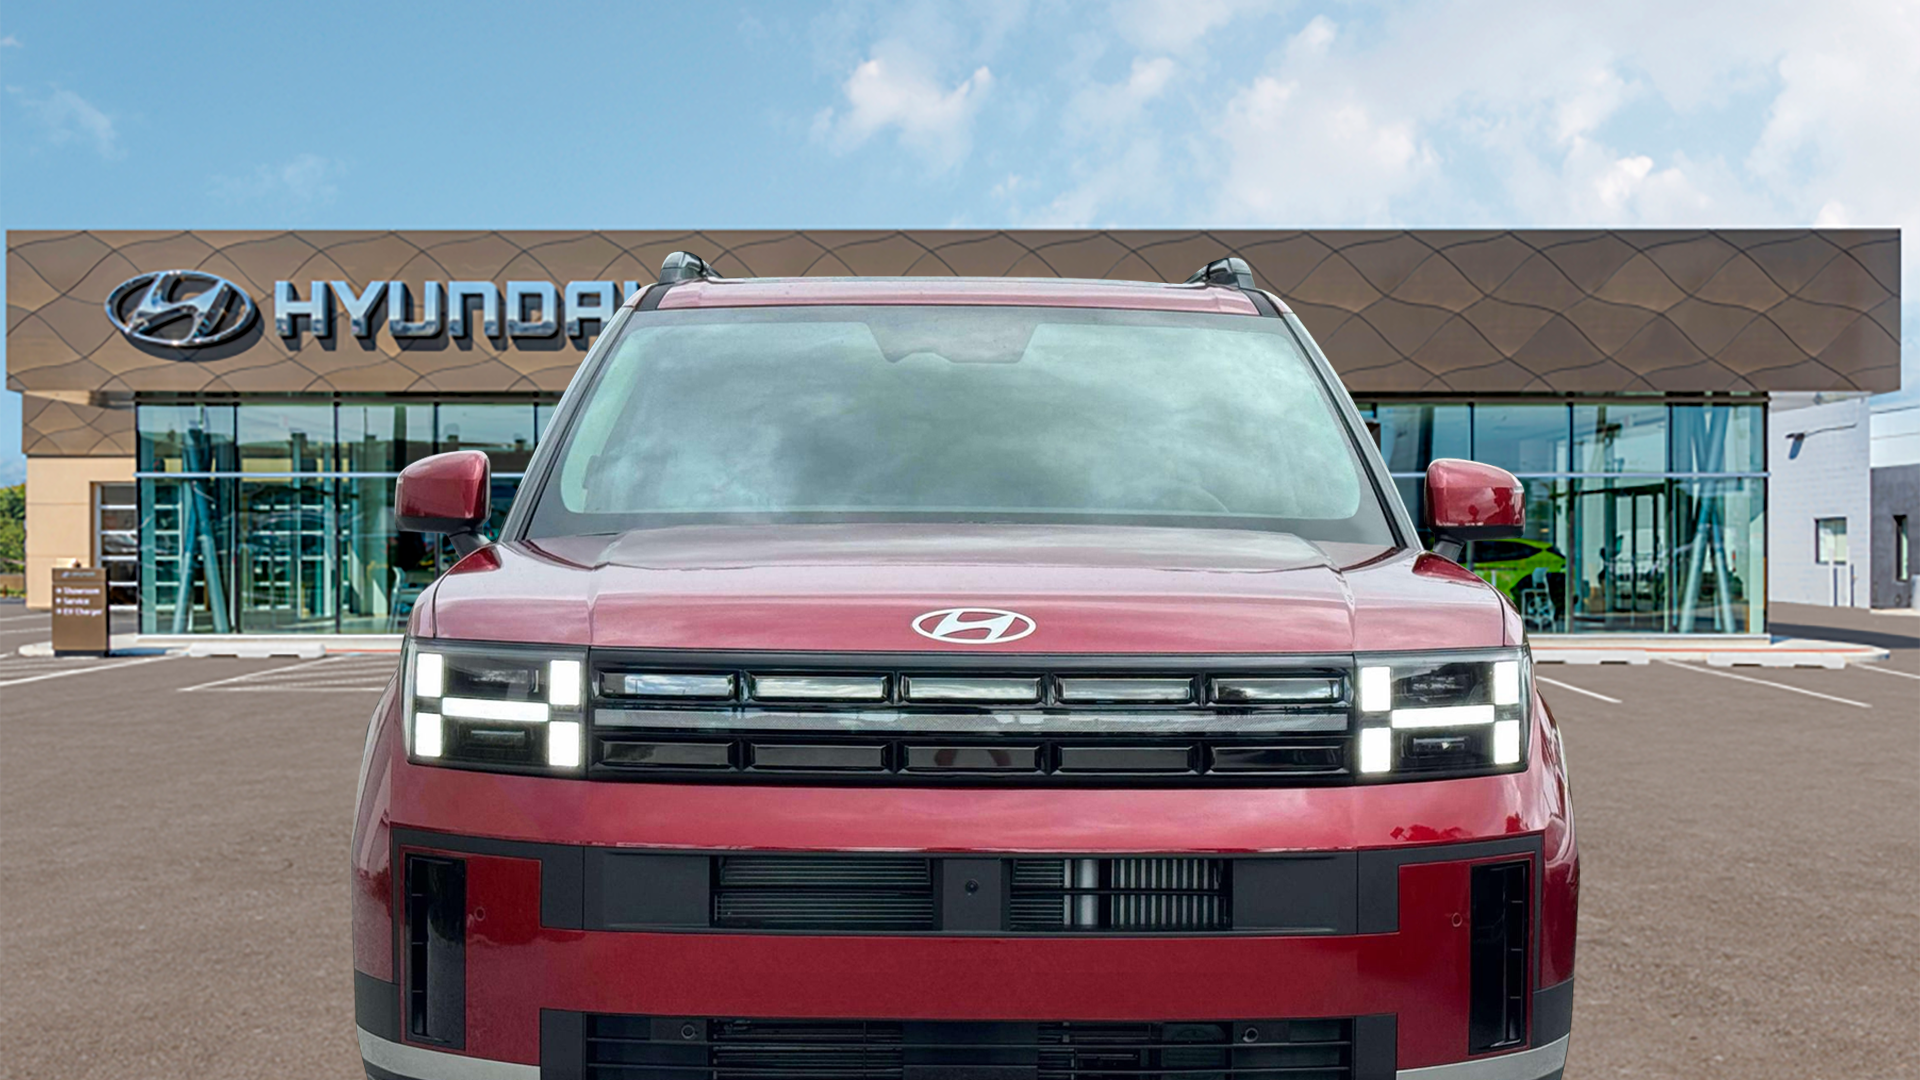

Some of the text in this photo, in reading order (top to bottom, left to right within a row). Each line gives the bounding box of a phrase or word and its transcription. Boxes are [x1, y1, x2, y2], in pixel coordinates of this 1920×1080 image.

[63, 587, 100, 595] Showroom
[63, 597, 90, 605] Service
[63, 608, 74, 616] EV
